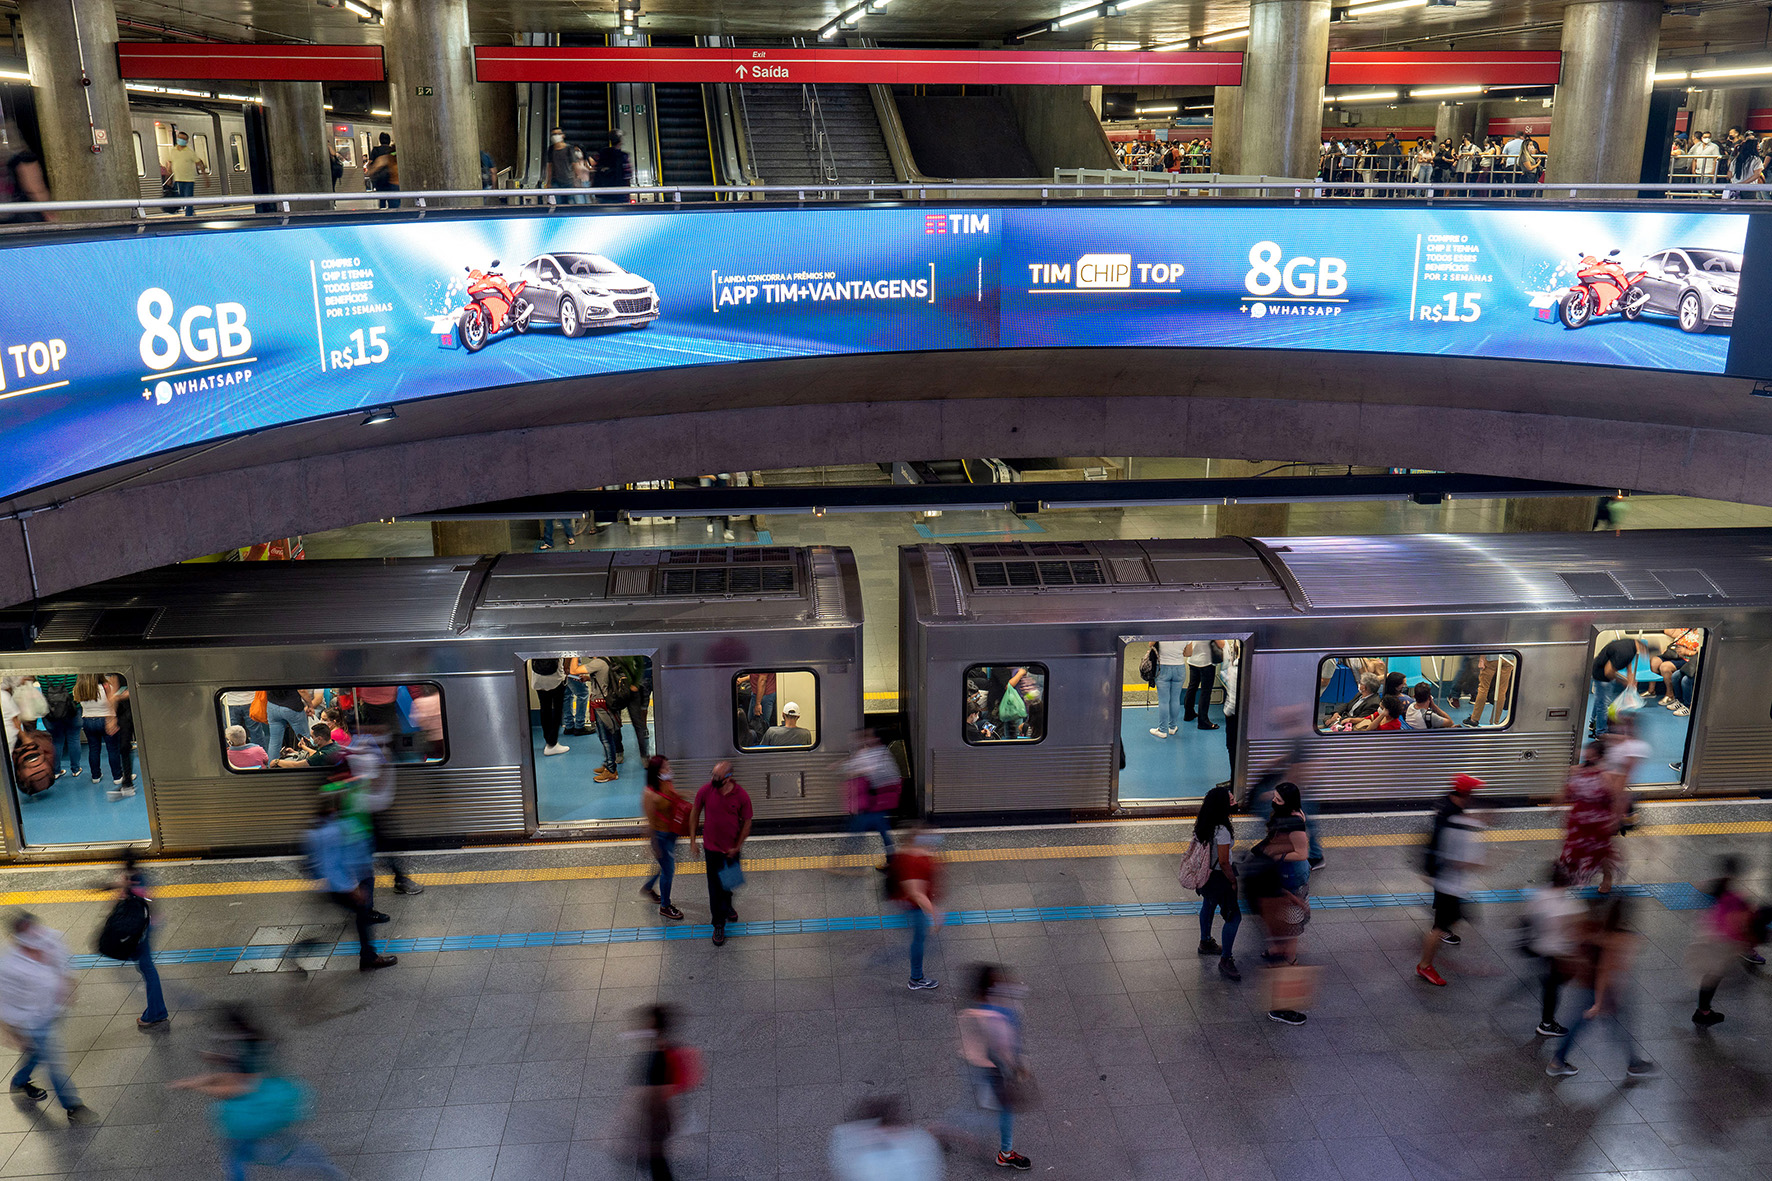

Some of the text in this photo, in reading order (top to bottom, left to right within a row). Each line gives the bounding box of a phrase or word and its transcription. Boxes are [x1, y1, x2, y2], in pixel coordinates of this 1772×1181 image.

[752, 65, 789, 78] Saída
[949, 214, 989, 234] TIM
[1428, 235, 1469, 243] COMPRE O
[1427, 244, 1445, 252] CHIP
[1452, 245, 1479, 253] TENHA
[321, 257, 361, 269] COMPRE O
[1426, 254, 1477, 262] TODOS ESSES
[322, 268, 374, 282] CHIP E TENHA
[1028, 263, 1185, 283] TIM CHIP TOP
[1244, 240, 1347, 297] 8GB
[718, 276, 723, 284] E
[724, 275, 746, 283] AINDA
[747, 273, 785, 283] CONCORRA
[793, 270, 823, 280] PRÊMIOS
[824, 271, 836, 279] NO
[1442, 273, 1448, 281] 2
[1450, 274, 1493, 282] SEMANAS
[323, 280, 374, 294] TODOS ESSES
[719, 278, 928, 305] APP TIM+VANTAGENS
[326, 302, 393, 318] POR 2 SEMANAS
[1269, 305, 1342, 317] WHATSAPP
[1420, 292, 1481, 323] R$15
[137, 287, 252, 370] 8GB
[330, 325, 389, 370] R$15
[8, 338, 67, 379] TOP
[173, 369, 253, 396] WHATSAPP
